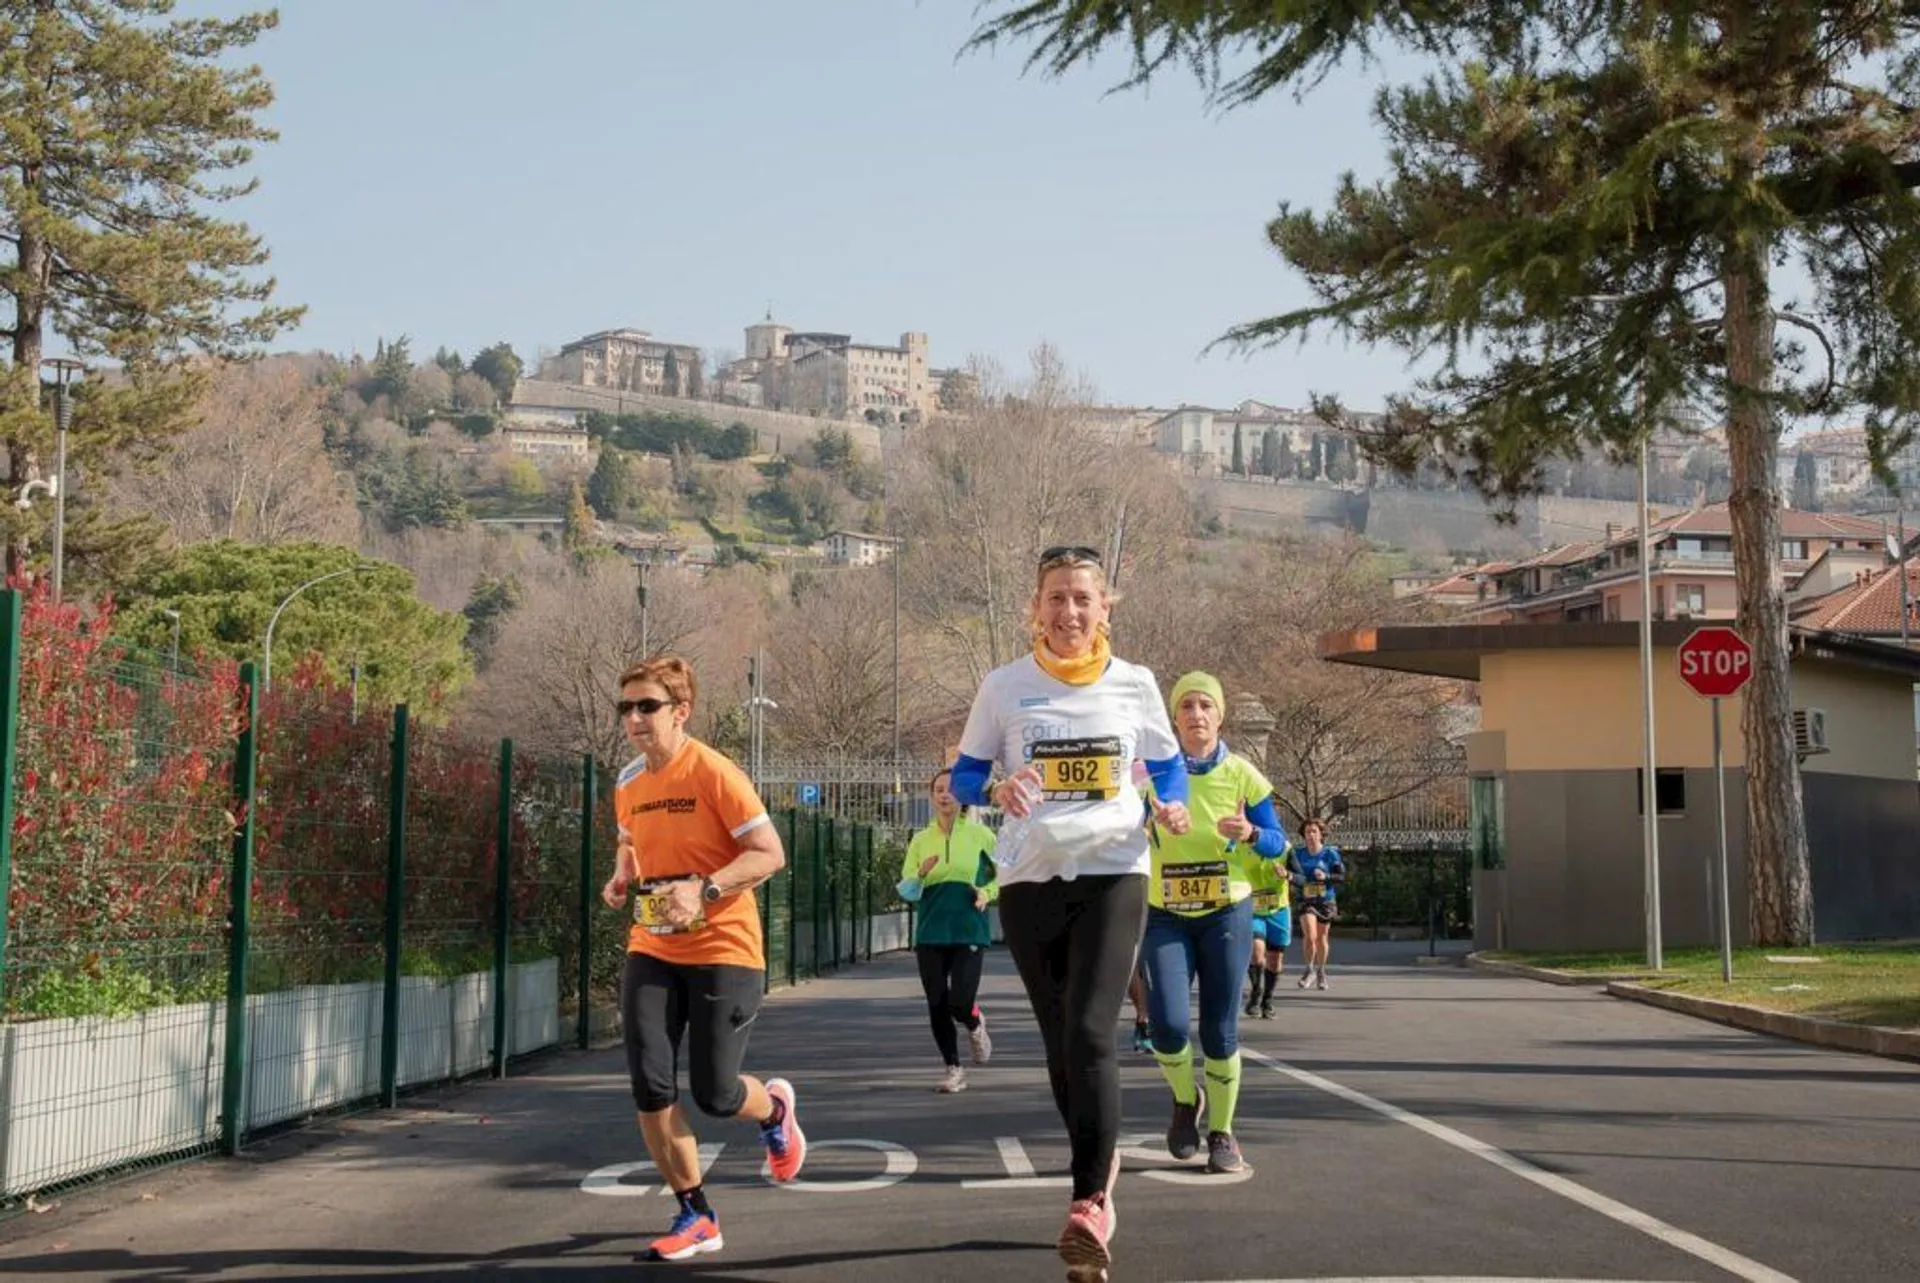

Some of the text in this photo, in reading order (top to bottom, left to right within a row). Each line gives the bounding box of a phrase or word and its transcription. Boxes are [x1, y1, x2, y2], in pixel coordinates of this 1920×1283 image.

[1682, 649, 1749, 675] STOP
[1057, 759, 1099, 783] 962
[802, 784, 816, 803] P
[1179, 879, 1211, 897] 847
